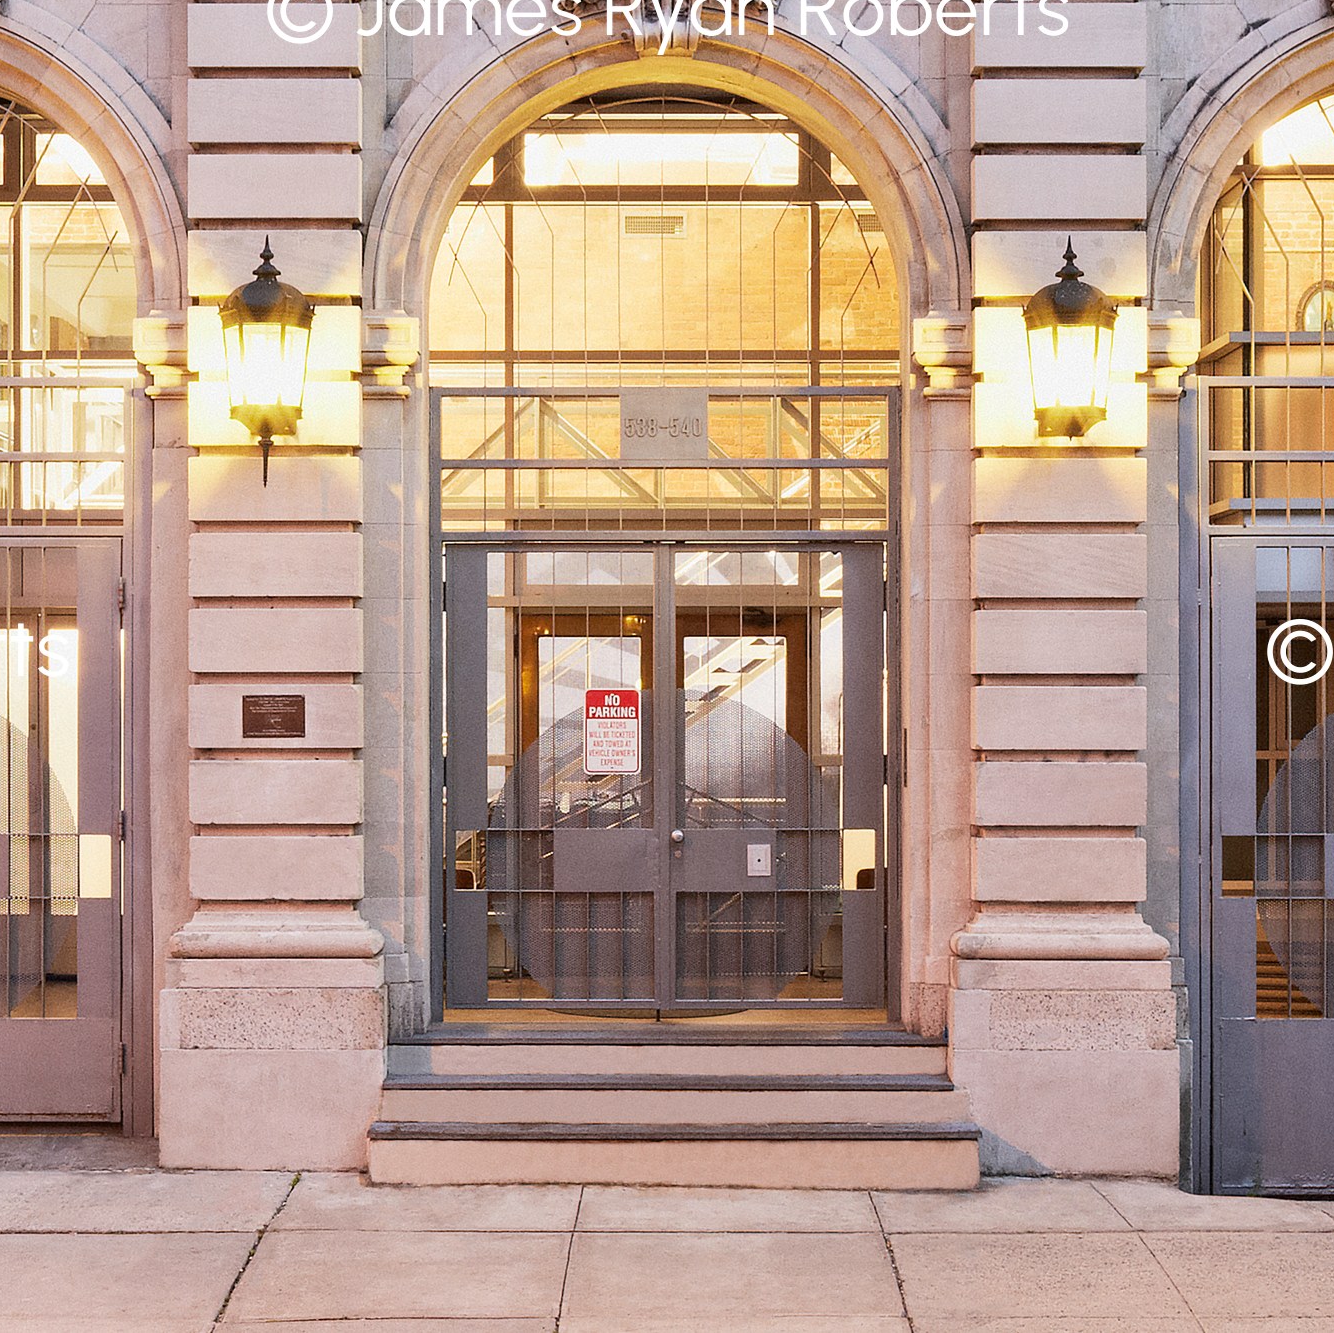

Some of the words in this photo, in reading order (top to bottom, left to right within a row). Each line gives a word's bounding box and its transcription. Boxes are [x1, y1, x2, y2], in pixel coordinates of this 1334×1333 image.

[624, 418, 703, 438] 538-540
[604, 694, 620, 706] NO
[588, 707, 636, 718] PARKING
